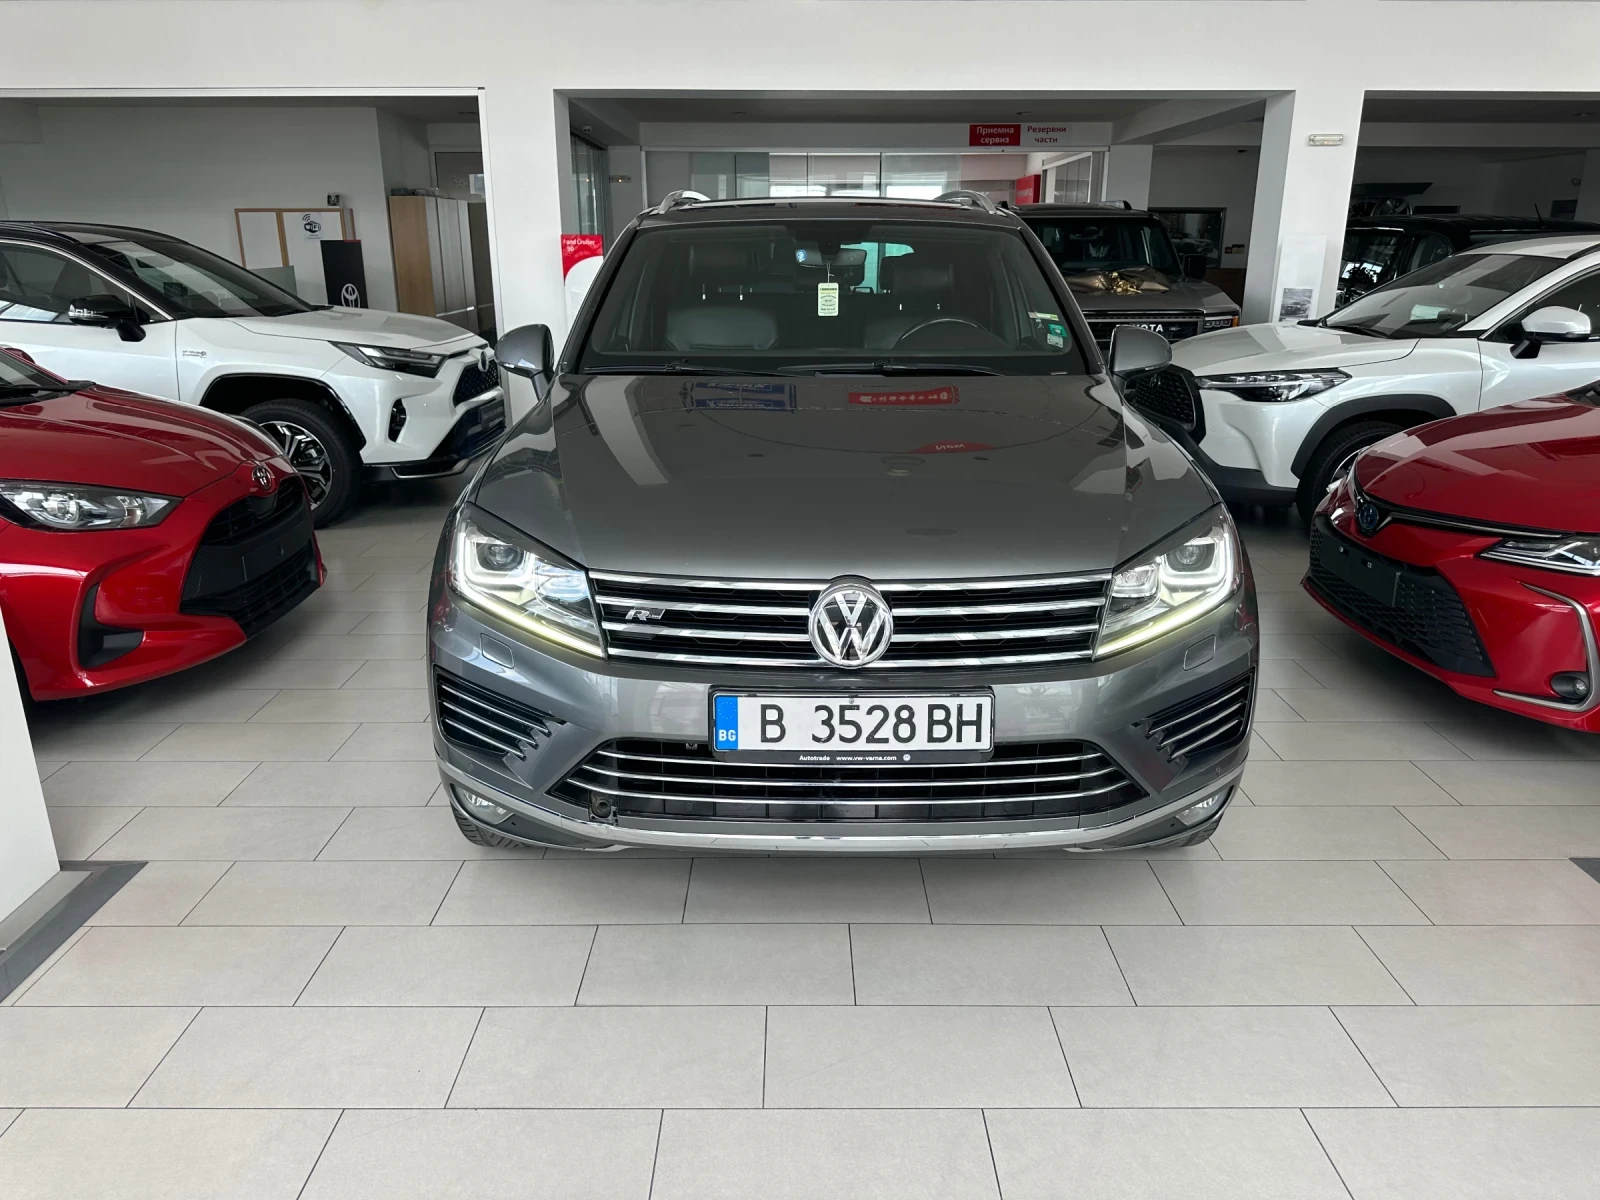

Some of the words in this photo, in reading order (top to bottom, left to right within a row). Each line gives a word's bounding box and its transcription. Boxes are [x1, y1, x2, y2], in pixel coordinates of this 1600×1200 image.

[976, 126, 1014, 136] Приемна
[1027, 125, 1067, 135] Резервни
[980, 136, 1010, 145] сервиз
[760, 703, 786, 743] B
[811, 703, 916, 744] 3528
[926, 703, 982, 743] BH
[718, 729, 736, 741] BG
[799, 754, 831, 762] Autotrade
